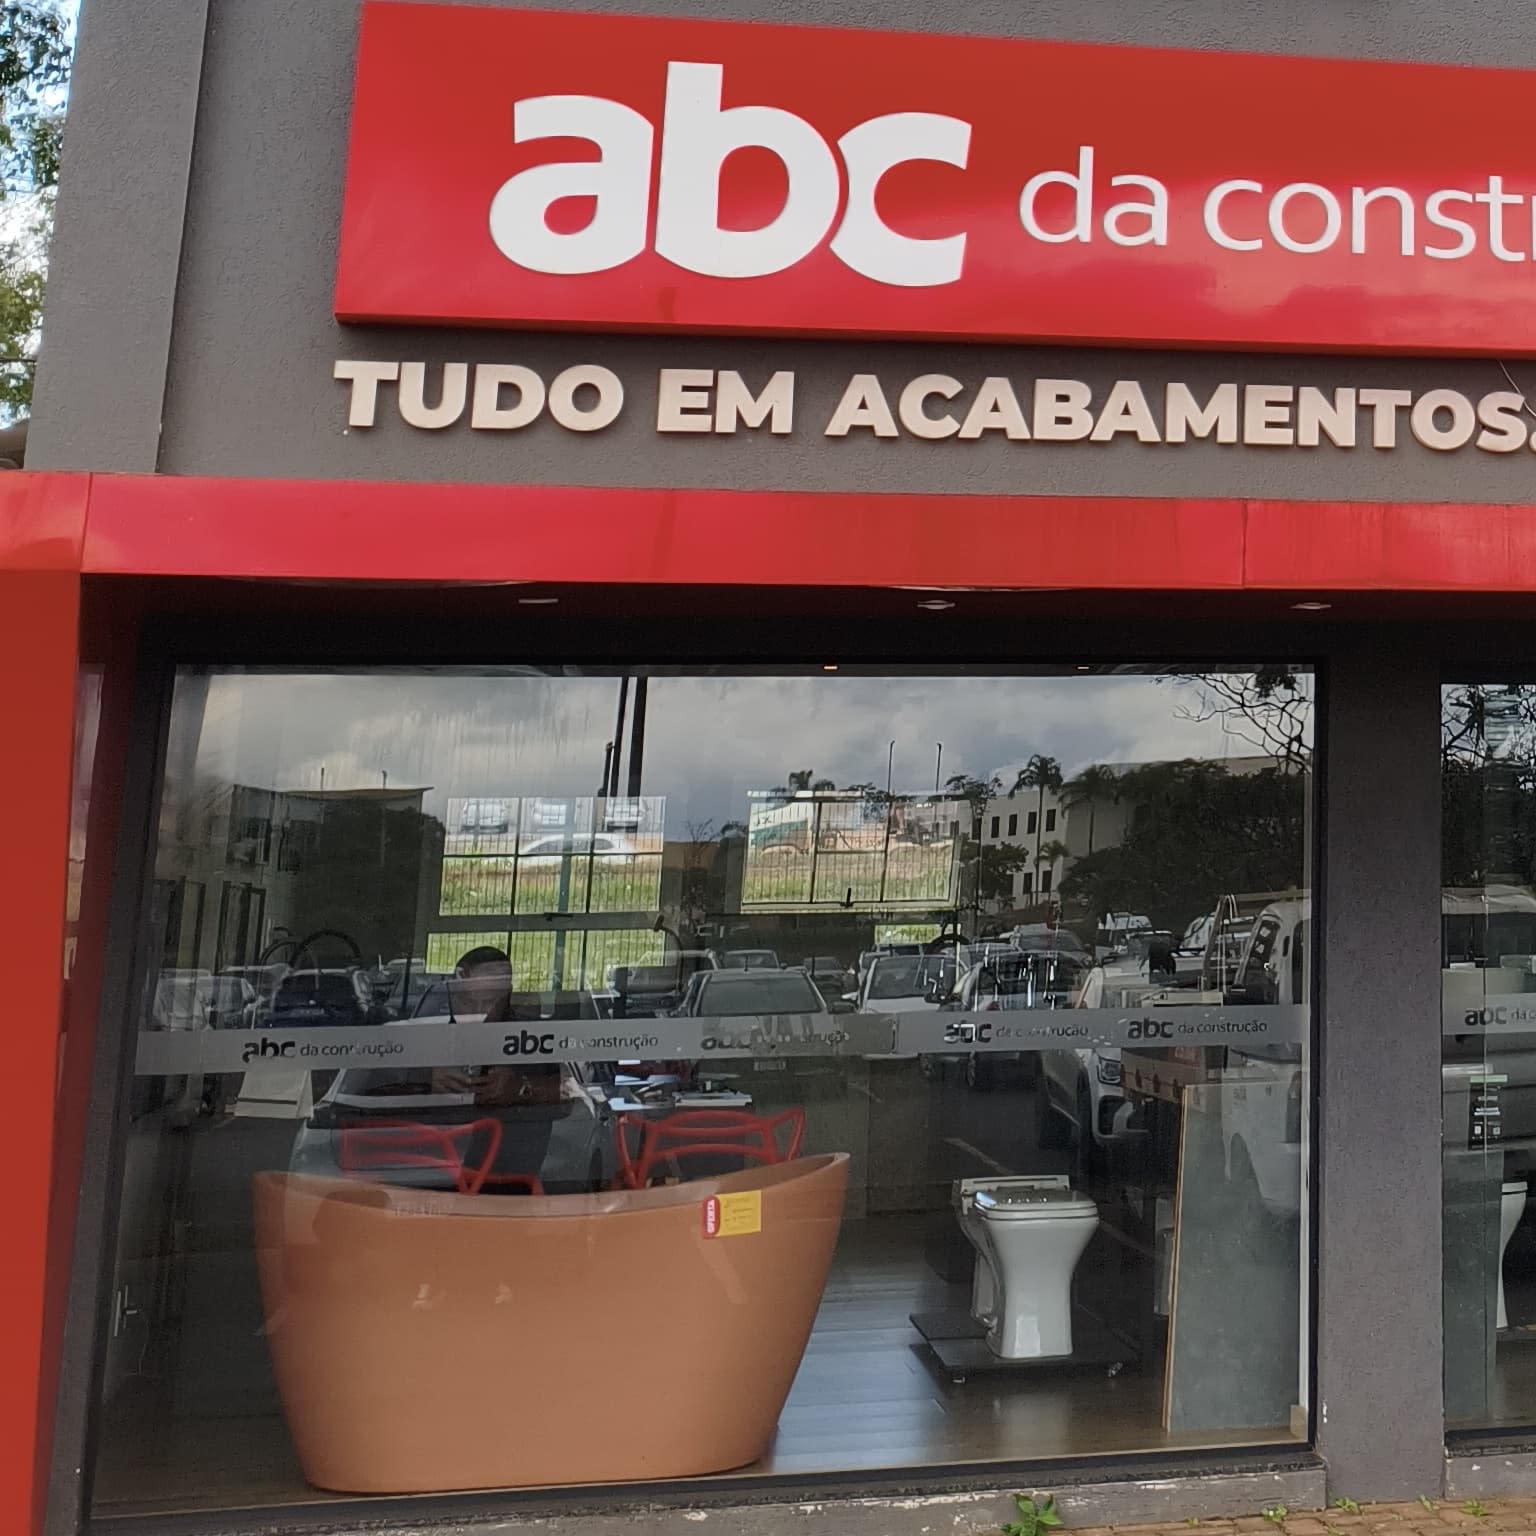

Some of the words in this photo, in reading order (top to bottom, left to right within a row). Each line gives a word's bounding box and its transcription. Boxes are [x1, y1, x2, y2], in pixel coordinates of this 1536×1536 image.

[487, 60, 973, 288] abc
[1018, 144, 1170, 248] da
[332, 358, 625, 432] TUDO
[655, 367, 796, 435] EM
[1127, 1016, 1174, 1040] abc
[1178, 1021, 1194, 1034] da
[1196, 1019, 1268, 1035] construção
[1464, 1005, 1508, 1027] abc
[241, 1036, 296, 1064] abc
[299, 1043, 319, 1057] da
[502, 1029, 555, 1056] abc
